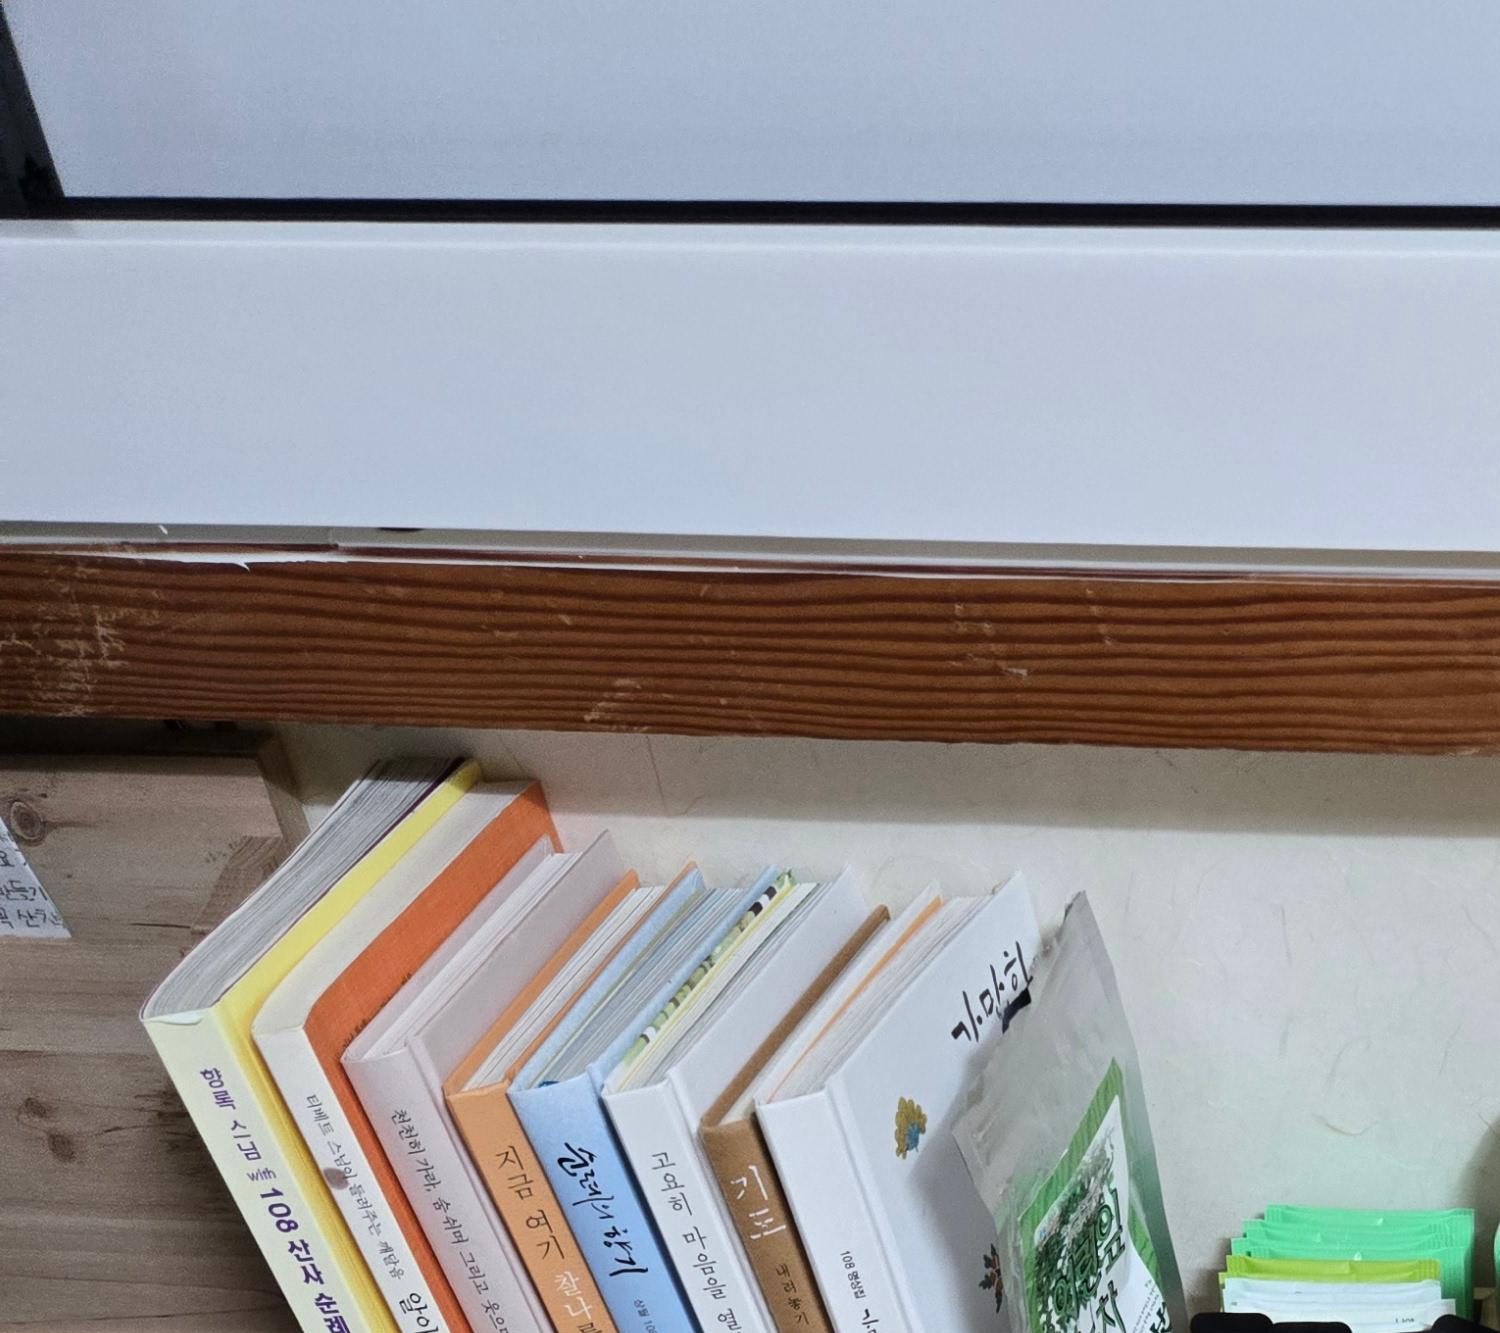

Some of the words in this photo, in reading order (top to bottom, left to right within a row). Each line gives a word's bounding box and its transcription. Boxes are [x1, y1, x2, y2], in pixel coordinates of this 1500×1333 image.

[246, 1166, 277, 1181] with
[259, 1187, 299, 1233] 108
[305, 1093, 334, 1136] 티베트
[327, 1141, 360, 1180] 스님이
[347, 1182, 382, 1237] 들려주는
[378, 1240, 404, 1280] 깨달음
[390, 1109, 426, 1155] 천천히
[415, 1157, 441, 1192] 가라,
[431, 1196, 451, 1213] 숨
[442, 1215, 469, 1244] 쉬며
[458, 1250, 489, 1295] 그리고
[495, 1144, 534, 1200] 지금
[525, 1208, 565, 1259] 여기
[556, 1141, 614, 1219] 순례의
[602, 1225, 648, 1277] 향기
[287, 1238, 324, 1285] 산사
[681, 1225, 726, 1300] 마음을
[839, 1250, 855, 1269] 108
[847, 1270, 866, 1299] 명상집
